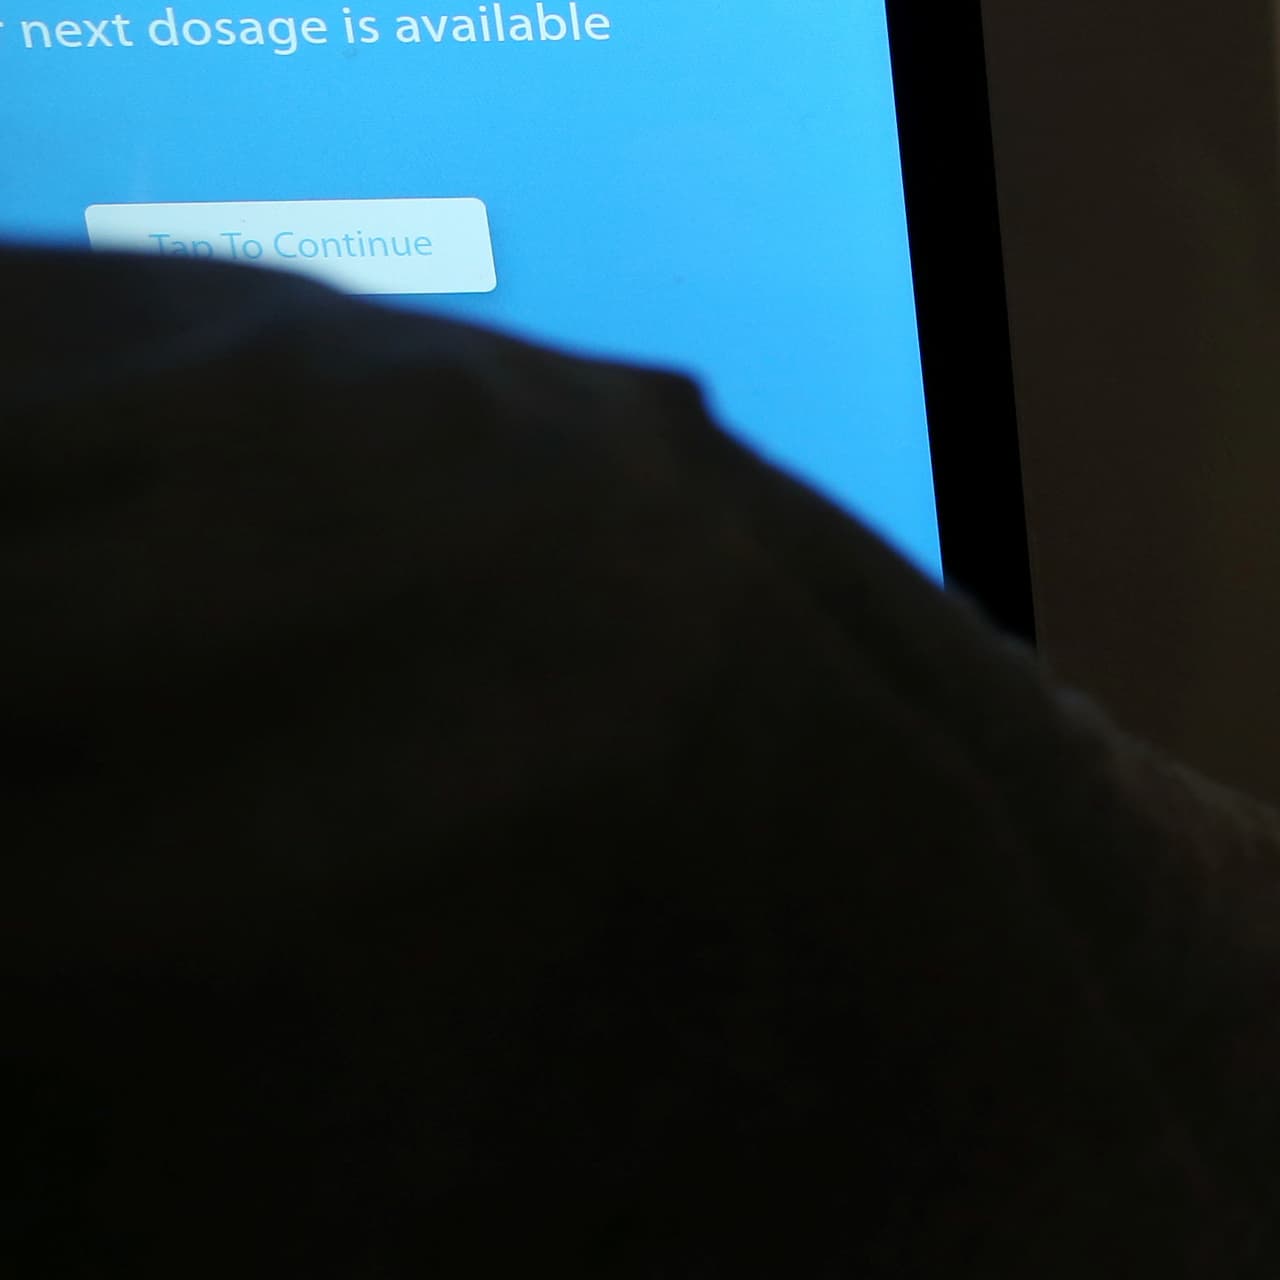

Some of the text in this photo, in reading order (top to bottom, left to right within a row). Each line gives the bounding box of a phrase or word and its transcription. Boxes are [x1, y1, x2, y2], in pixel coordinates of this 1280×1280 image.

[19, 13, 135, 49] next
[148, 7, 329, 56] dosage
[341, 7, 380, 45] is
[395, 1, 612, 45] available
[219, 231, 264, 260] To
[273, 230, 434, 259] Continue
